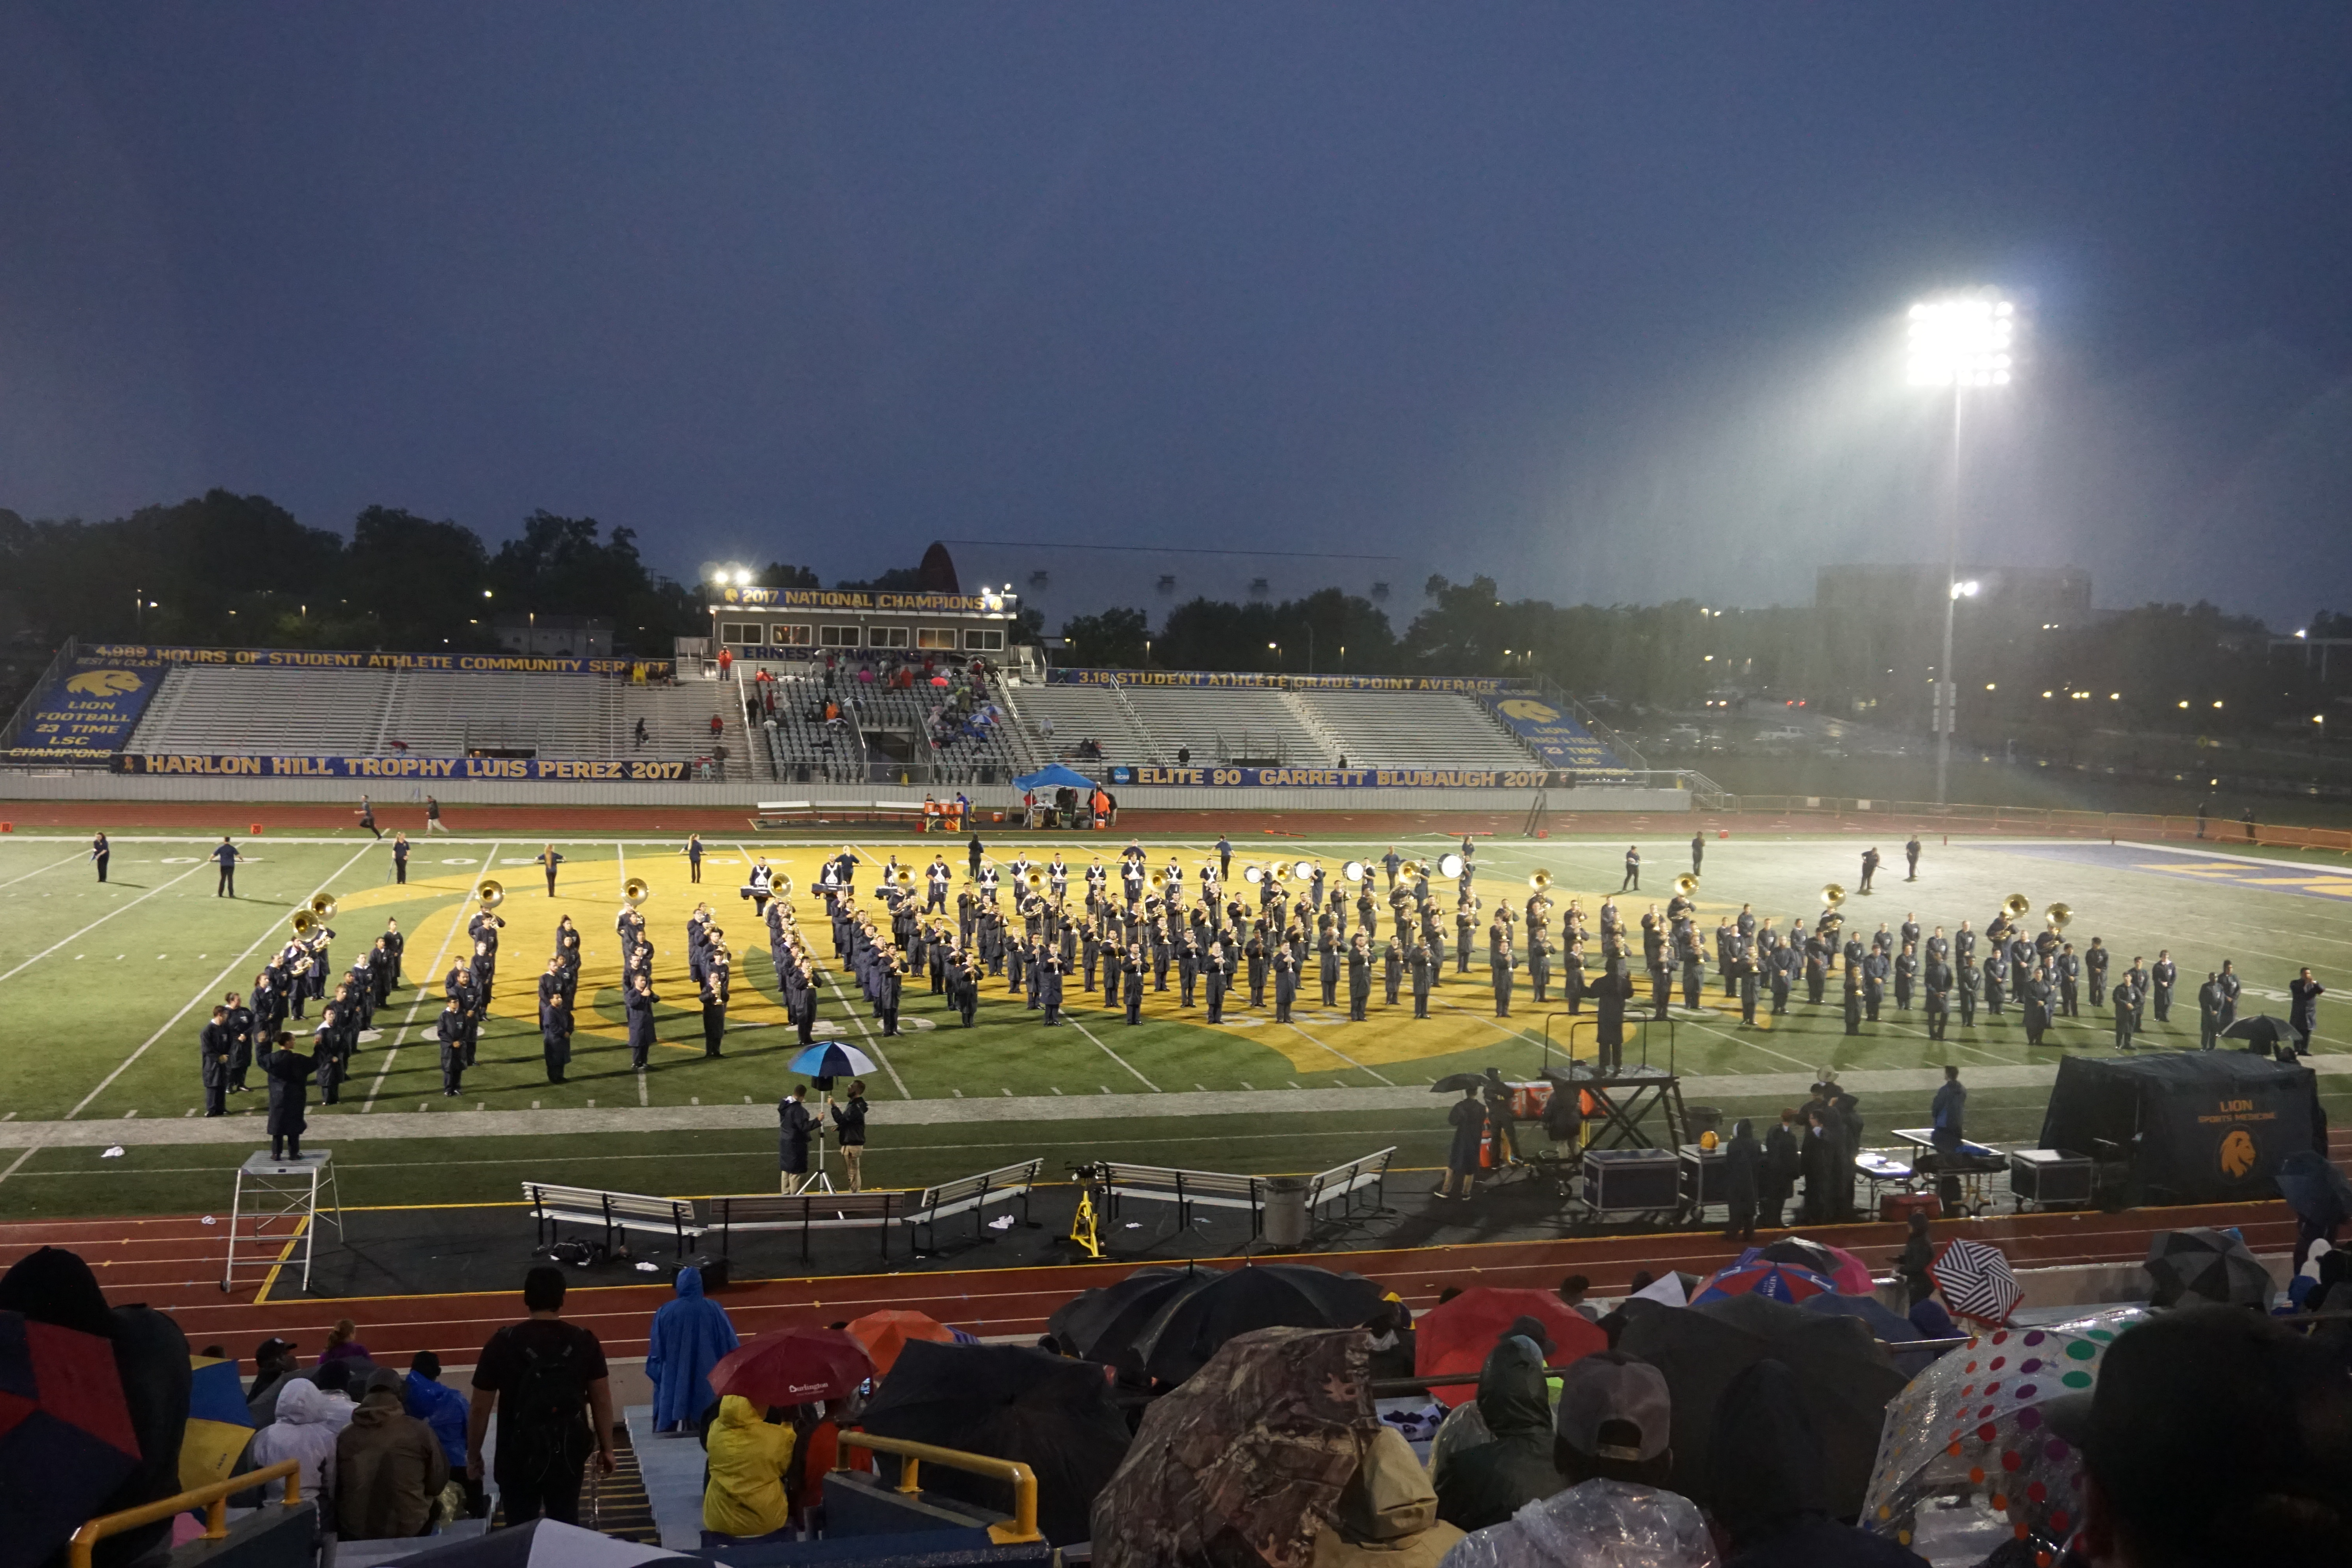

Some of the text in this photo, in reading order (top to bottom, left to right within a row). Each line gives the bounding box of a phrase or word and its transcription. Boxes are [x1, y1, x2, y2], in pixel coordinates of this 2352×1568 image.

[742, 588, 986, 610] 2017 NATIONAL CHAMPIONS
[96, 646, 147, 657] 4,989
[157, 650, 227, 662] HOURS
[236, 651, 260, 664] OF
[269, 652, 361, 666] STUDENT
[368, 655, 453, 668] ATHLETE
[460, 657, 582, 671] COMMUNITY
[743, 646, 817, 660] ERNEST
[1079, 672, 1499, 690] 3.18 STUDENT ATHLETE GRADE POINT AVERAGE
[68, 701, 116, 710] LION
[35, 712, 131, 722] FOOTBALL
[35, 724, 120, 734] 23 TIME
[49, 736, 90, 745] LSC
[145, 755, 684, 779] HARLON HILL TROPHY LUIS PEREZ 2017
[1138, 768, 1549, 787] ELITE 90 GARRETT BLUBAUGH 2017
[2220, 1100, 2252, 1112] LION
[1767, 1275, 1778, 1298] ANGERS
[789, 1383, 828, 1392] Burlington
